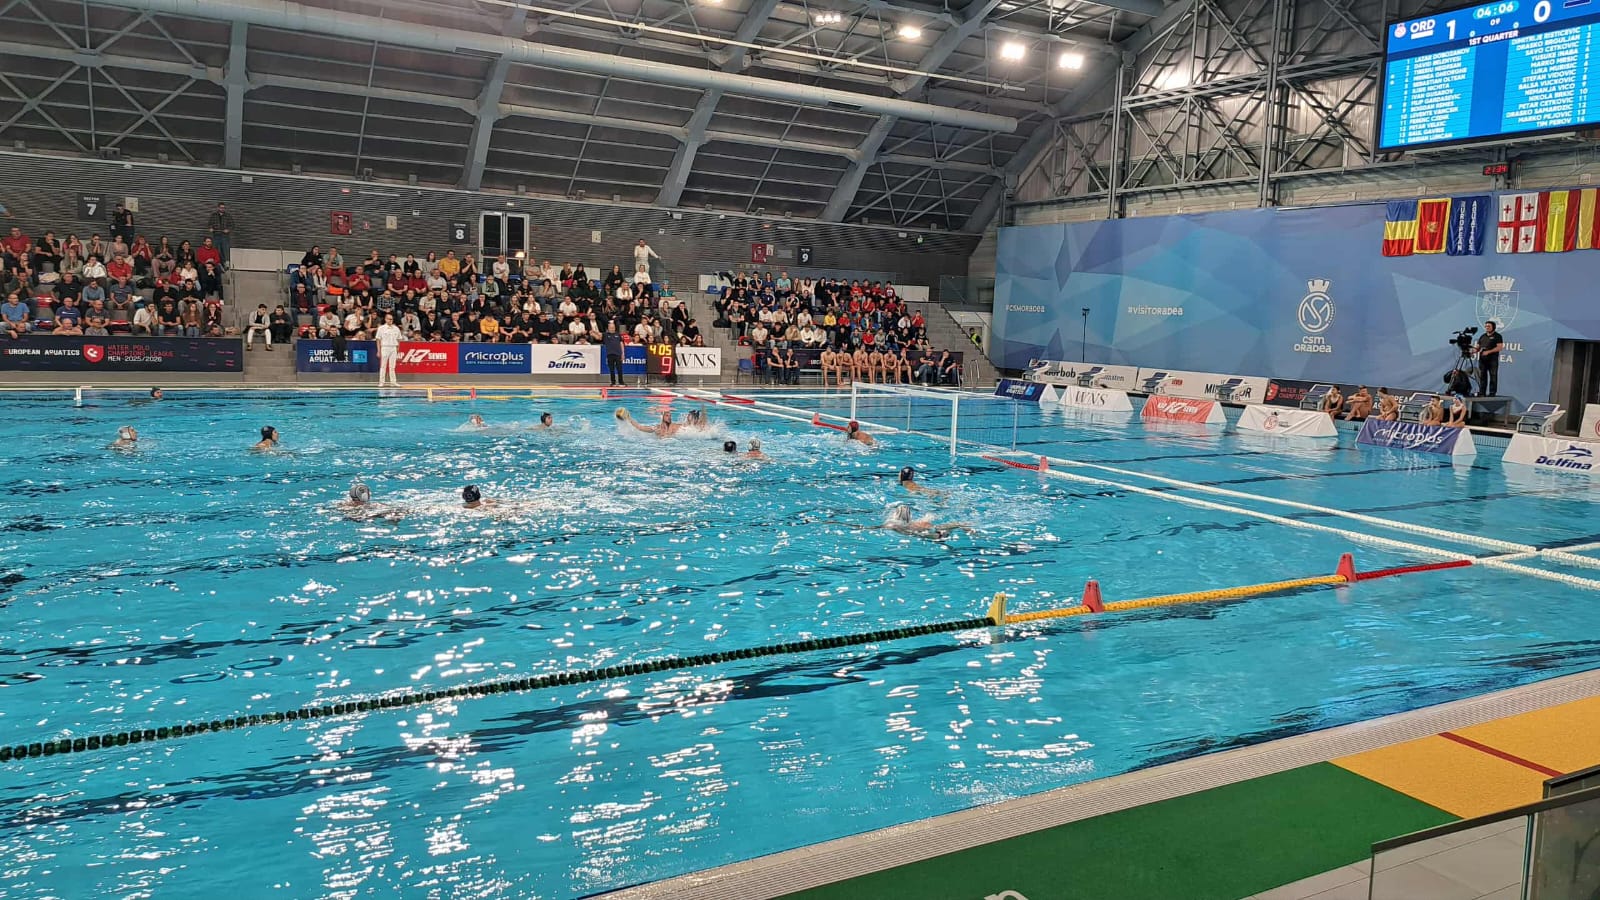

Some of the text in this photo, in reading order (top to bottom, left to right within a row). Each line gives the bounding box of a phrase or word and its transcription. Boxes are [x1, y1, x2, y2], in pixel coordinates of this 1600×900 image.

[1477, 2, 1514, 18] 04:06
[1534, 1, 1550, 23] 0
[1410, 19, 1435, 33] ORD
[1446, 20, 1456, 40] 1
[1469, 30, 1518, 46] 1ST QUARTER
[86, 203, 96, 216] 7
[456, 229, 464, 240] 8
[802, 253, 809, 262] 9
[662, 356, 672, 373] 9
[1535, 456, 1592, 470] Delfina
